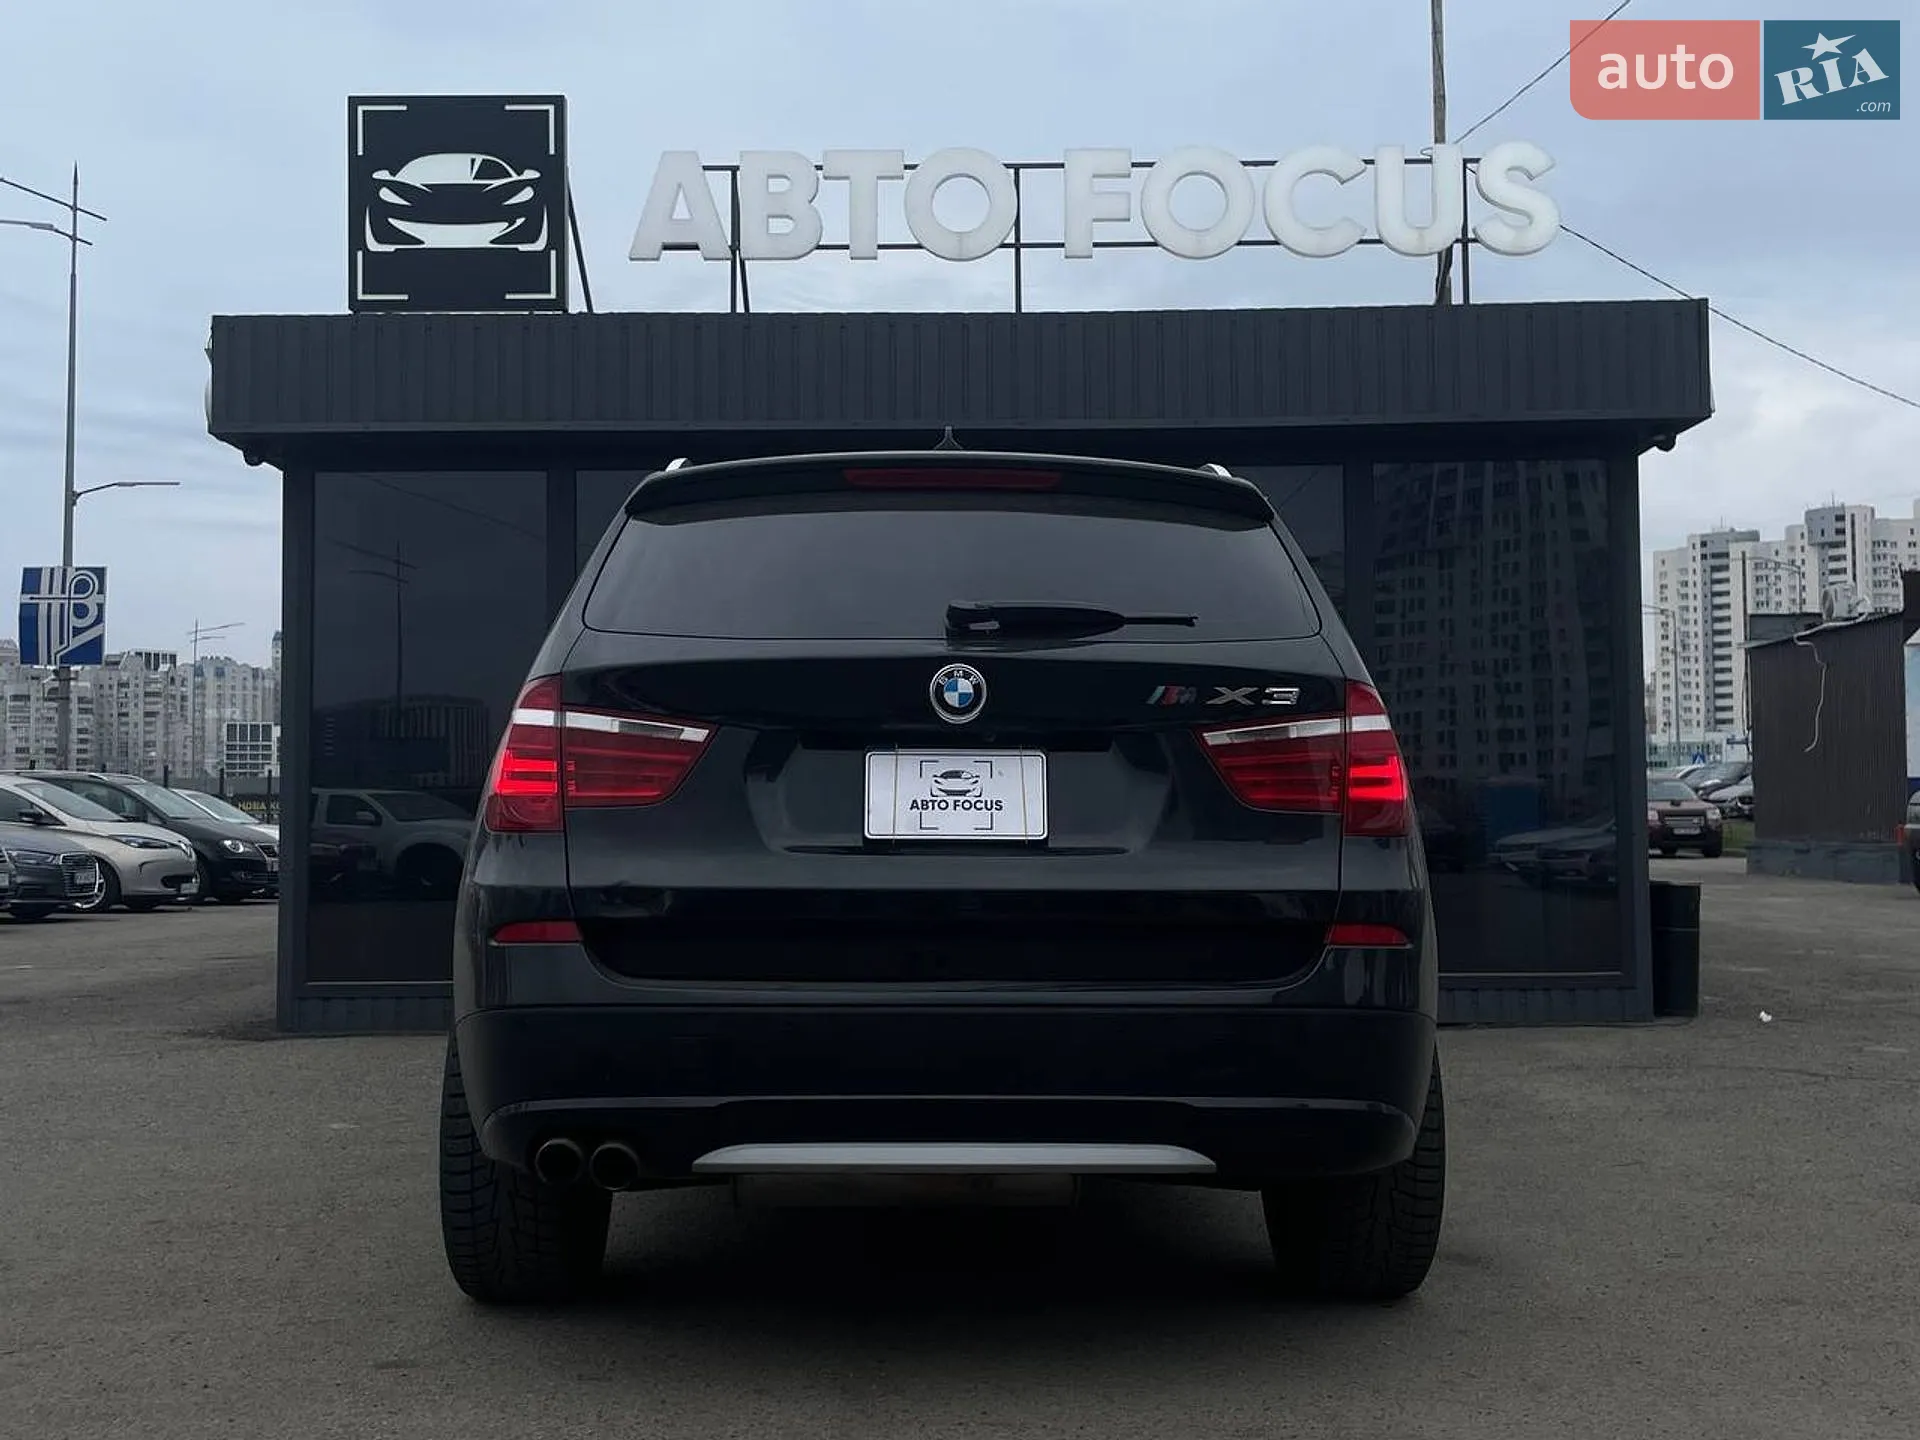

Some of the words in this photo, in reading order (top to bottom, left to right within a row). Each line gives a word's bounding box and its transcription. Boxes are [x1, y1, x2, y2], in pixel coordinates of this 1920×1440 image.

[1064, 141, 1561, 259] FOCUS
[1206, 686, 1300, 705] X3
[953, 799, 1003, 811] FOCUS
